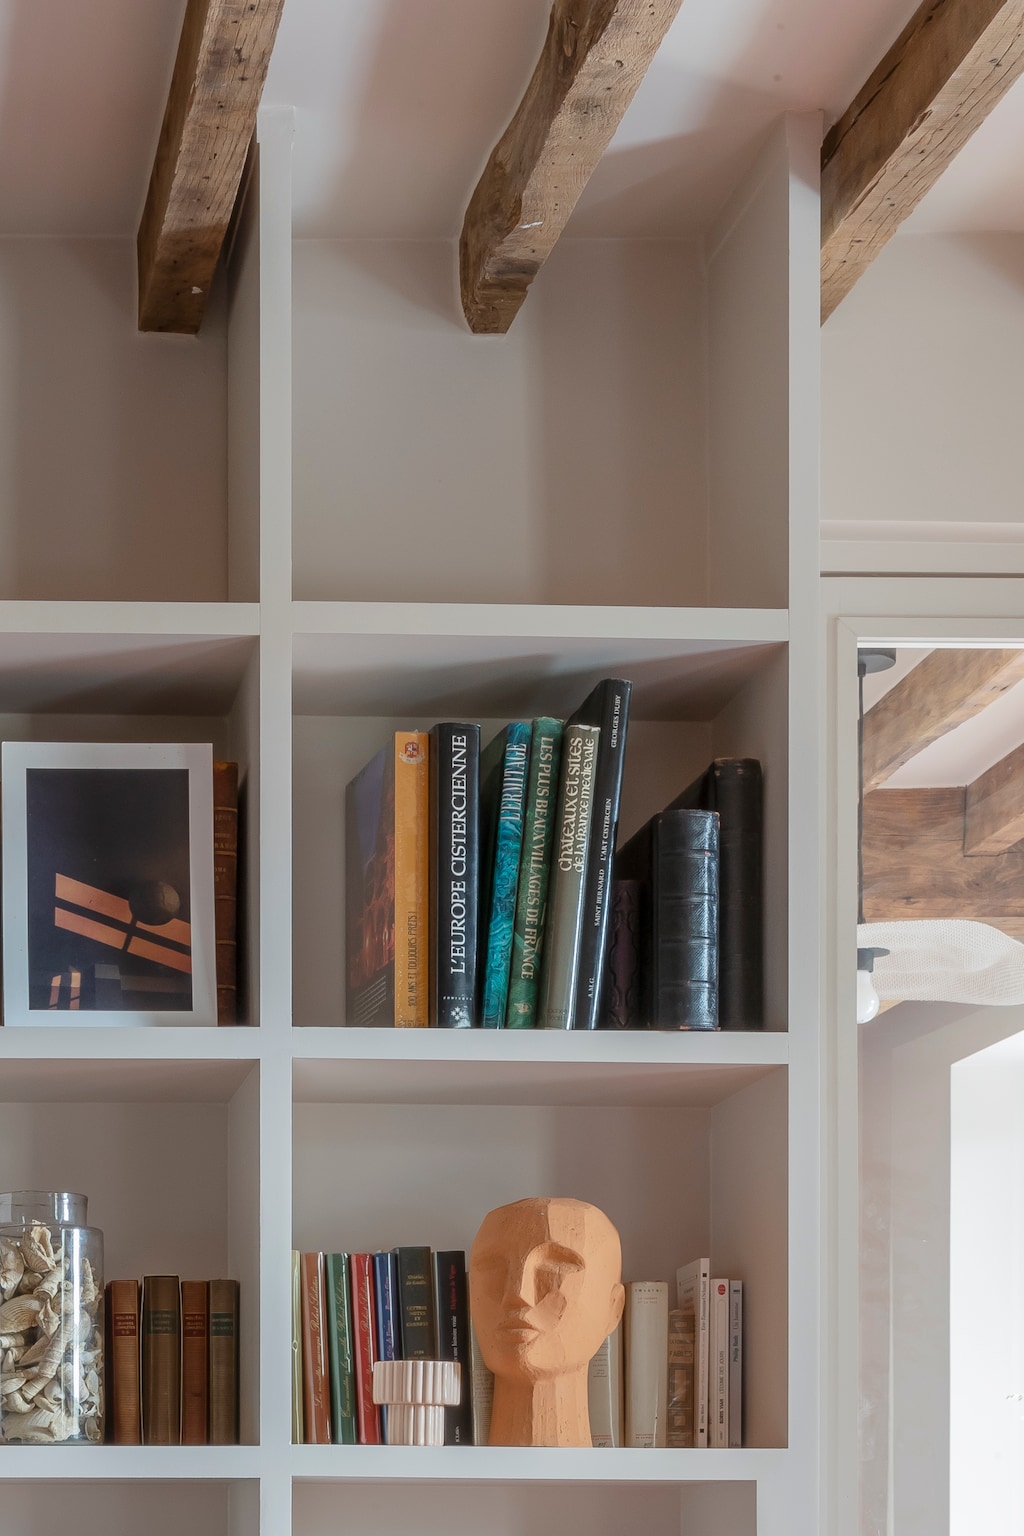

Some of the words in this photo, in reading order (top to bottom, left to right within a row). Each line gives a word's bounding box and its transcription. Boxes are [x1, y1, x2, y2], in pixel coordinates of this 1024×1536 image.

[613, 694, 622, 714] DUBY
[539, 736, 554, 761] LES
[610, 714, 620, 748] GEORGES
[499, 742, 527, 821] L'ERMITAGE
[537, 763, 552, 797] PLUS
[450, 735, 467, 877] CISTERCIENNE
[531, 799, 549, 845] BEAUX
[602, 798, 613, 839] CISTERCIEN
[599, 839, 608, 861] L'ART
[525, 846, 545, 906] VILLAGES
[596, 868, 605, 903] BERNARD
[450, 880, 466, 975] L'EUROPE
[525, 907, 539, 926] DE
[594, 902, 602, 927] SAINT
[521, 928, 538, 980] FRANCE
